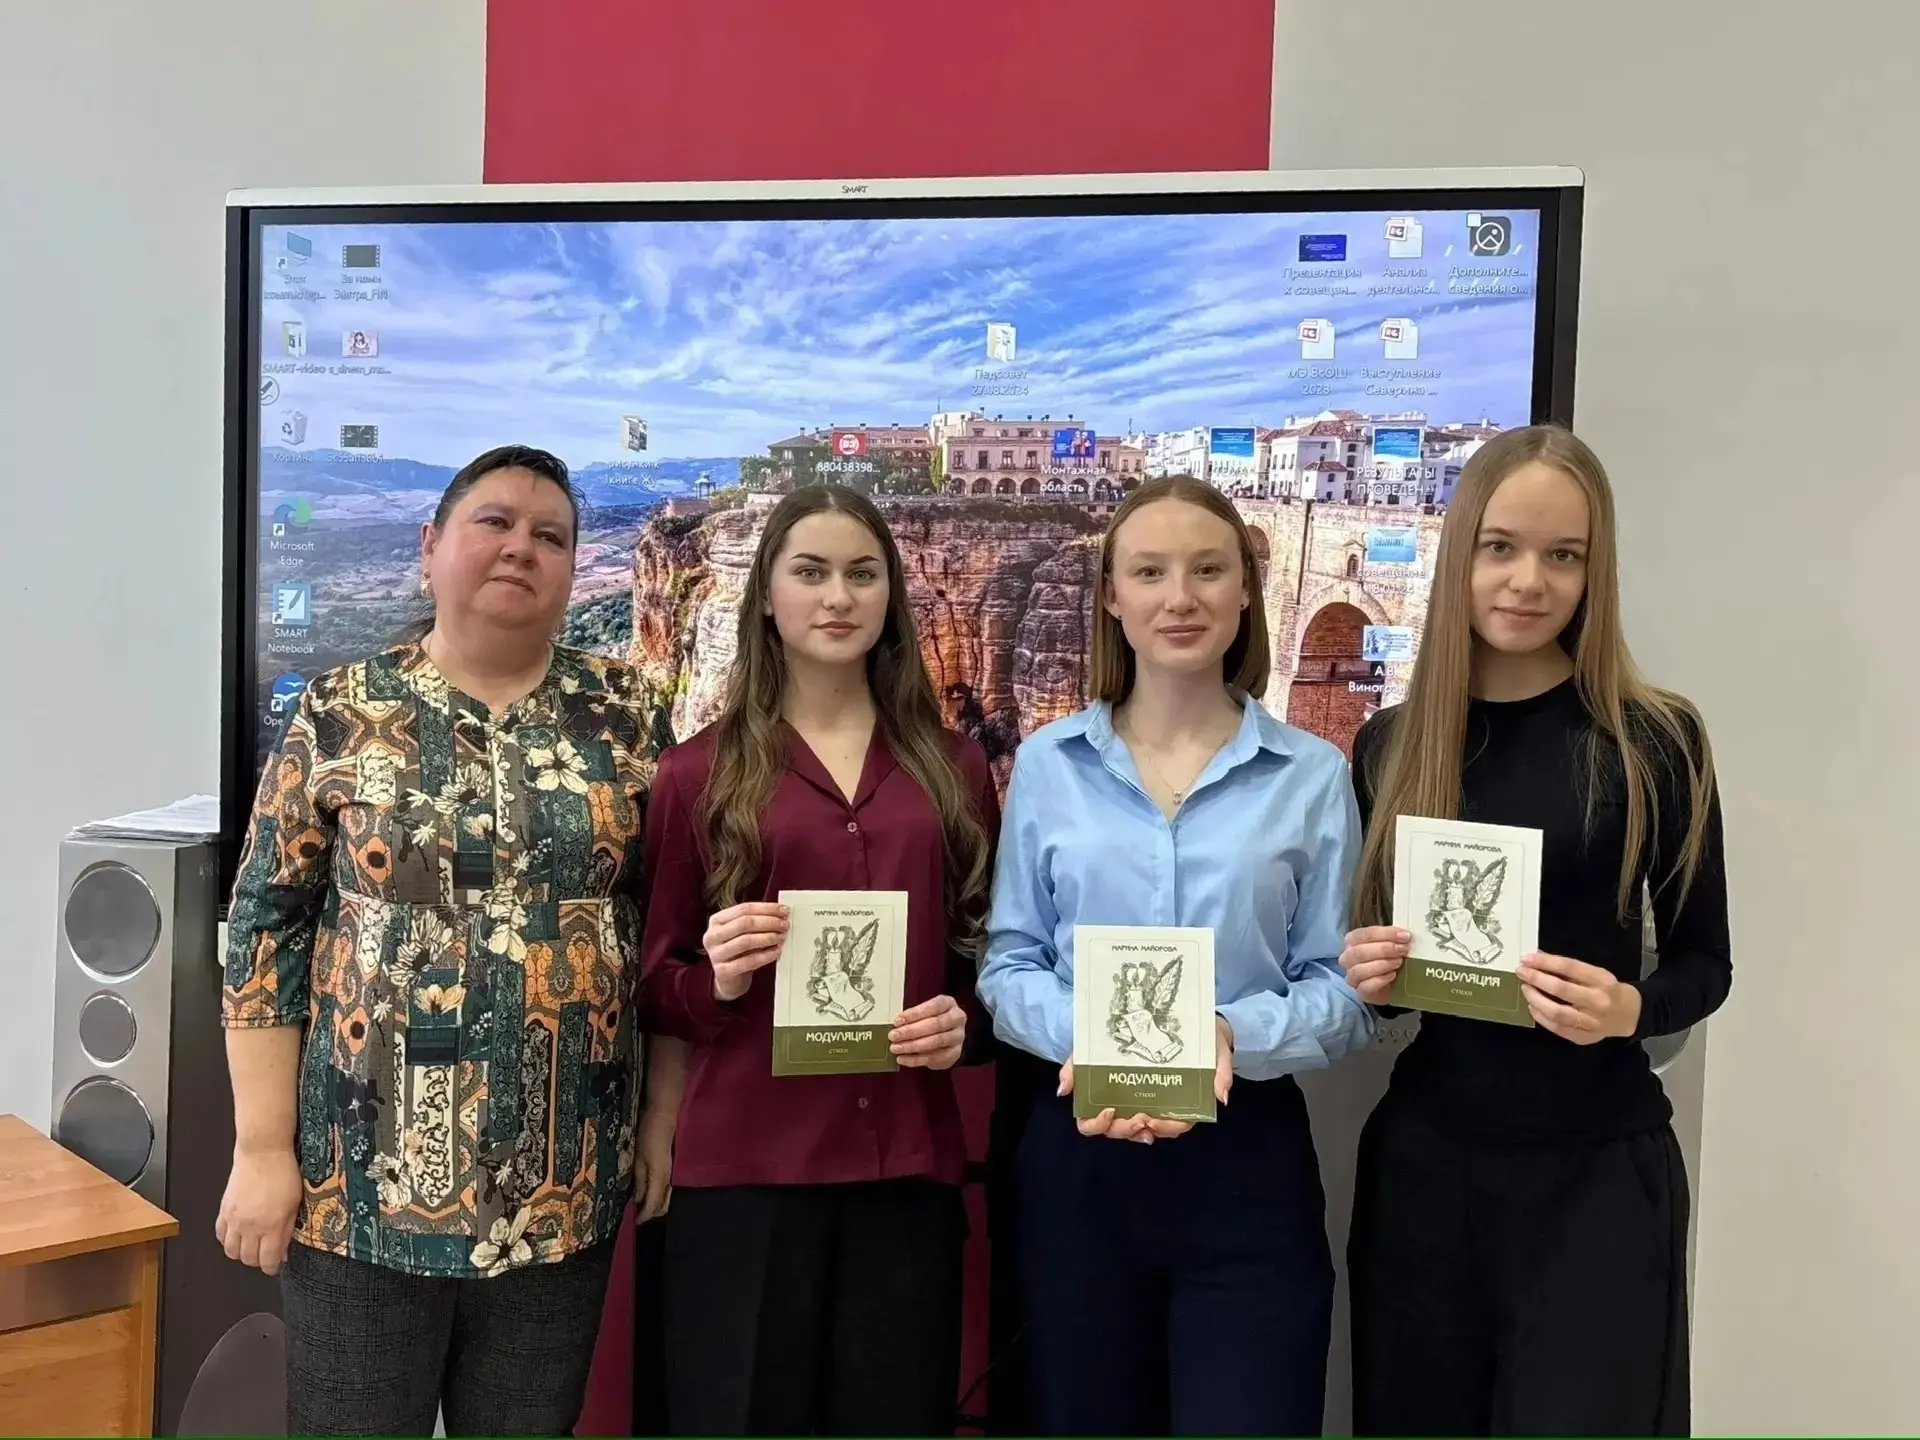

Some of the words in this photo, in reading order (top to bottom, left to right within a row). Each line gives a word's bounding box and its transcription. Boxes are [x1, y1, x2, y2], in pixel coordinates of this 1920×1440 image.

[841, 185, 868, 194] SMART
[1383, 265, 1428, 278] Анализ
[1448, 284, 1506, 296] сведения
[1360, 367, 1442, 381] Выступление
[1041, 465, 1106, 475] Монтажная
[1357, 466, 1437, 479] РЕЗУЛЬТАТЫ
[1040, 481, 1084, 492] область
[270, 541, 315, 551] Microsoft
[280, 556, 304, 567] Edge
[274, 628, 309, 638] SMART
[267, 643, 315, 654] Notebook
[1425, 967, 1501, 988] МОДУЛЯЦИЯ
[805, 1031, 873, 1043] МОДУЛЯЦИЯ
[1108, 1072, 1183, 1087] МОДУЛЯЦИЯ
